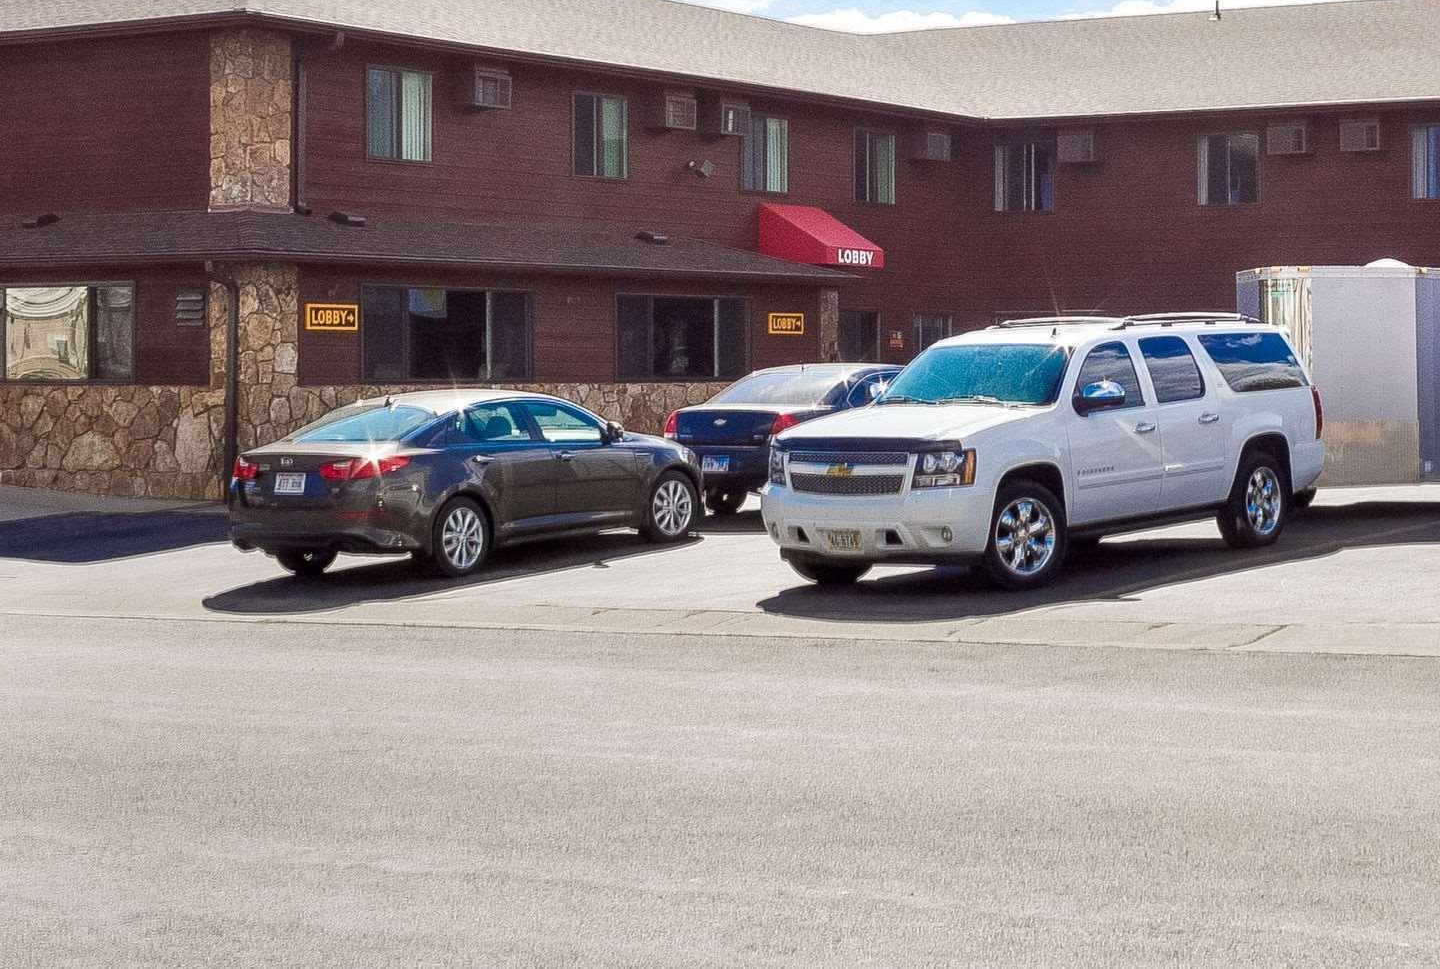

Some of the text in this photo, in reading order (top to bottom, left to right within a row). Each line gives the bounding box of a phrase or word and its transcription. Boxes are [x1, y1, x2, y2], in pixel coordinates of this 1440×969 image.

[838, 249, 874, 266] LOBBY
[311, 310, 347, 325] LOBBY
[773, 318, 796, 330] LOBBY
